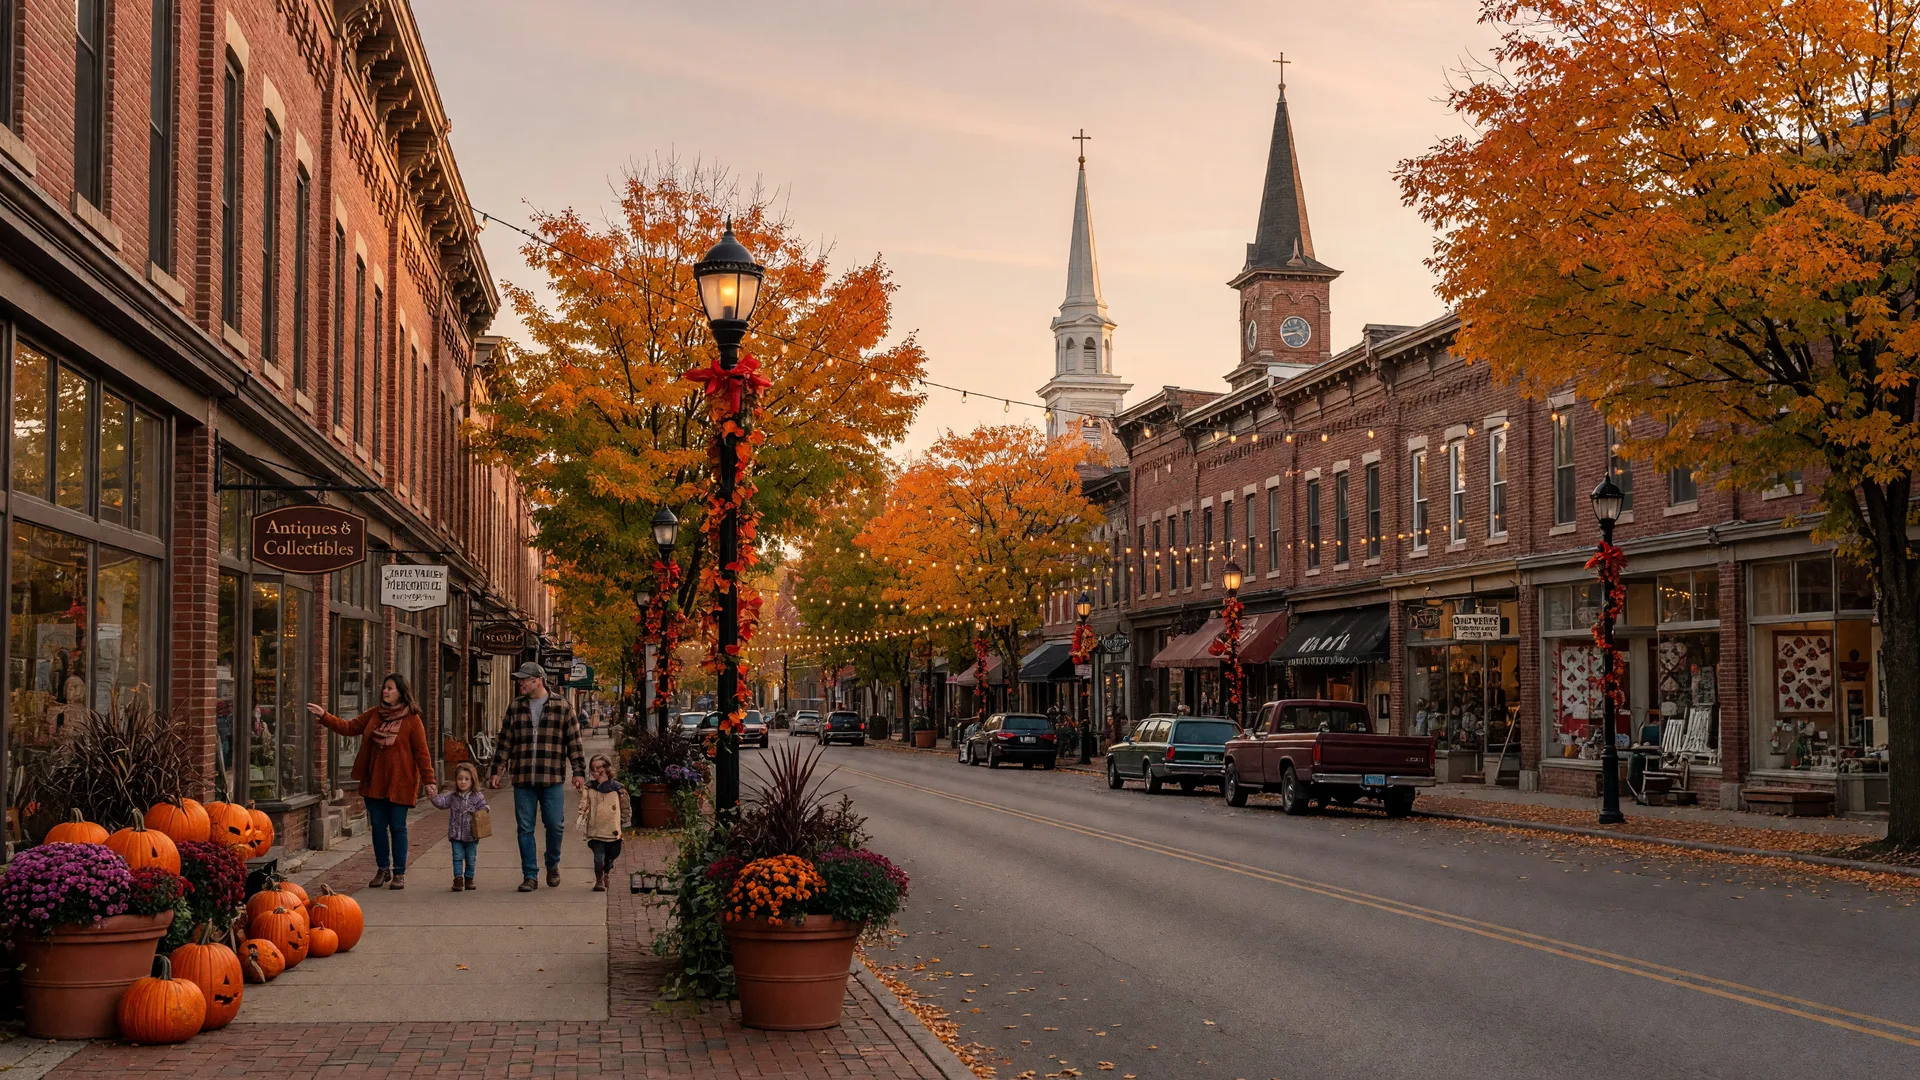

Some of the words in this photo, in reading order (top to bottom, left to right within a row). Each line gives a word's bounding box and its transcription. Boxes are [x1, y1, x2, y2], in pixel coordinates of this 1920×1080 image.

[266, 520, 337, 539] Antiques
[341, 521, 351, 535] &
[263, 540, 354, 555] Collectibles
